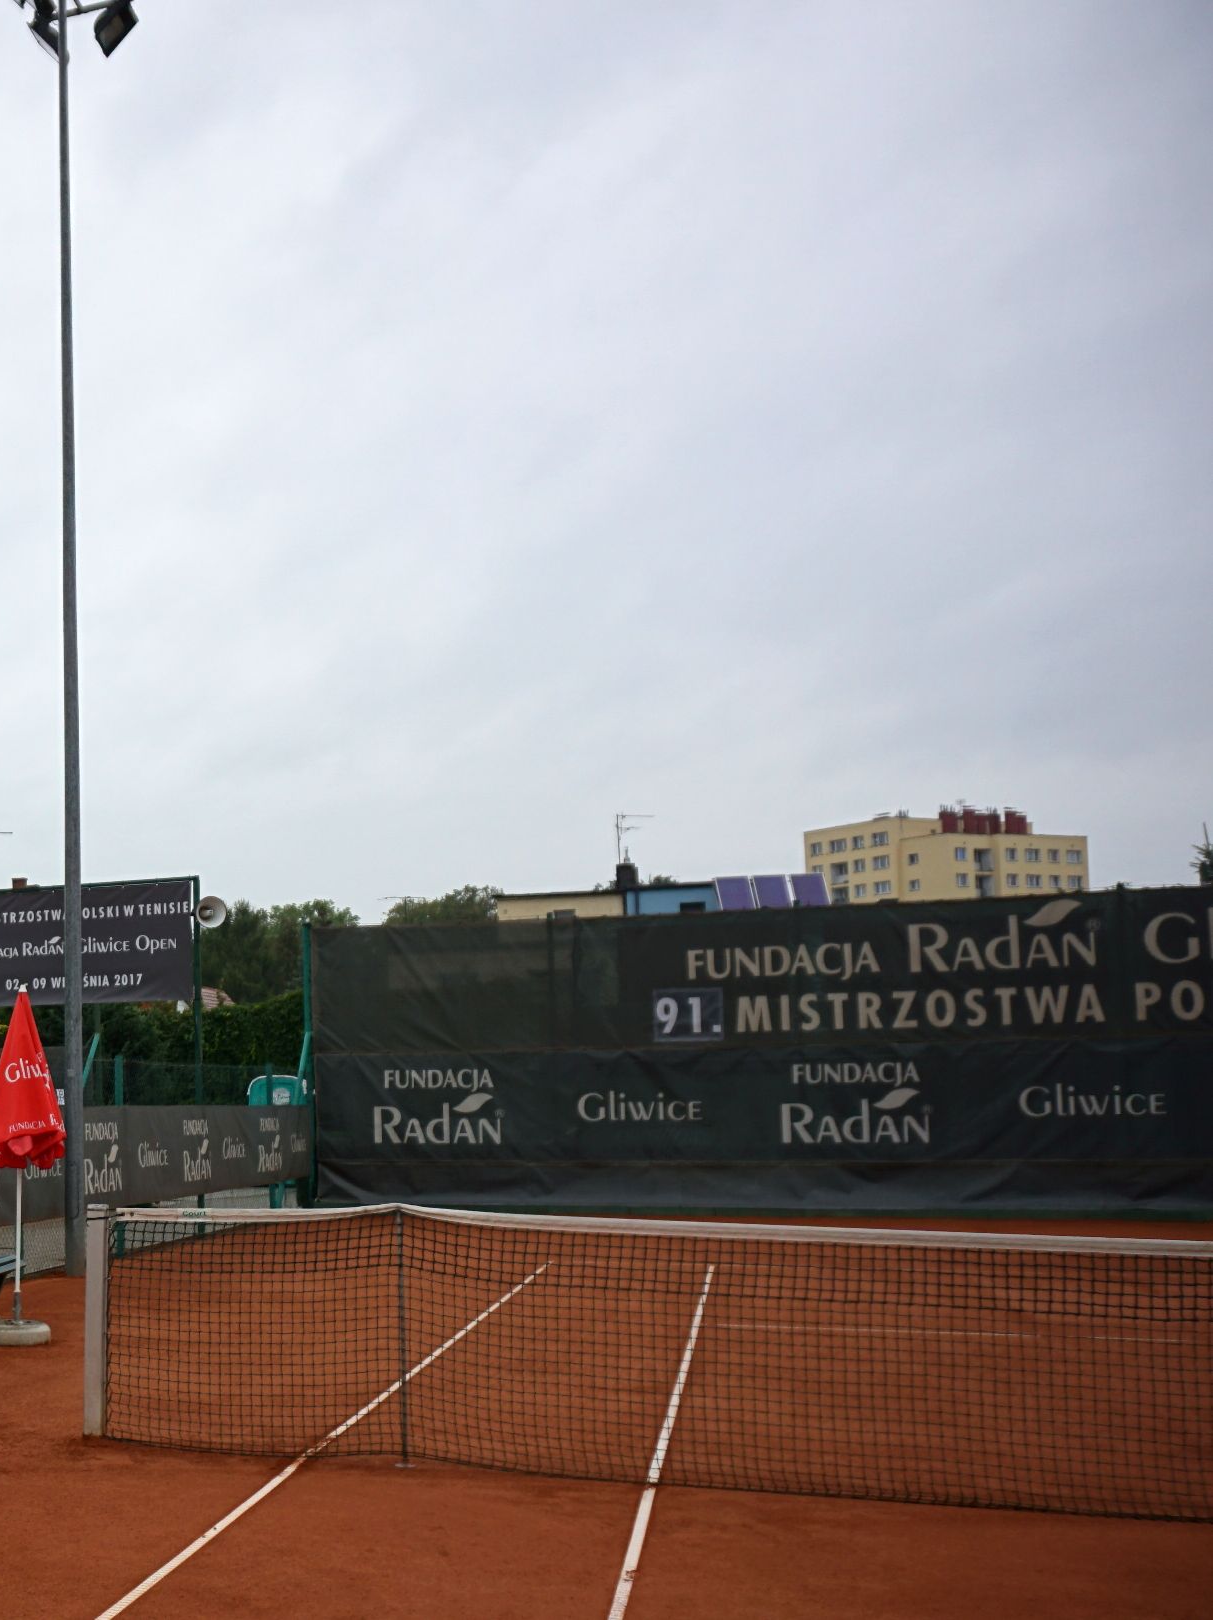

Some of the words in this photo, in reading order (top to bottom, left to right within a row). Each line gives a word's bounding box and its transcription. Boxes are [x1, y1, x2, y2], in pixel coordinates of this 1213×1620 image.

[82, 905, 119, 919] OLSKI
[124, 905, 134, 917] W
[138, 901, 189, 916] TENISIE
[687, 941, 881, 980] FUNDACJA
[6, 978, 19, 990] 02
[33, 978, 46, 989] 09
[114, 973, 143, 986] 2017
[656, 996, 722, 1034] 91.
[737, 983, 1105, 1033] MISTRZOSTWA
[384, 1068, 494, 1090] FUNDACJA
[792, 1061, 920, 1087] FUNDACJA
[84, 1122, 119, 1143] FUNDACJA
[183, 1119, 209, 1137] FUNDACJA
